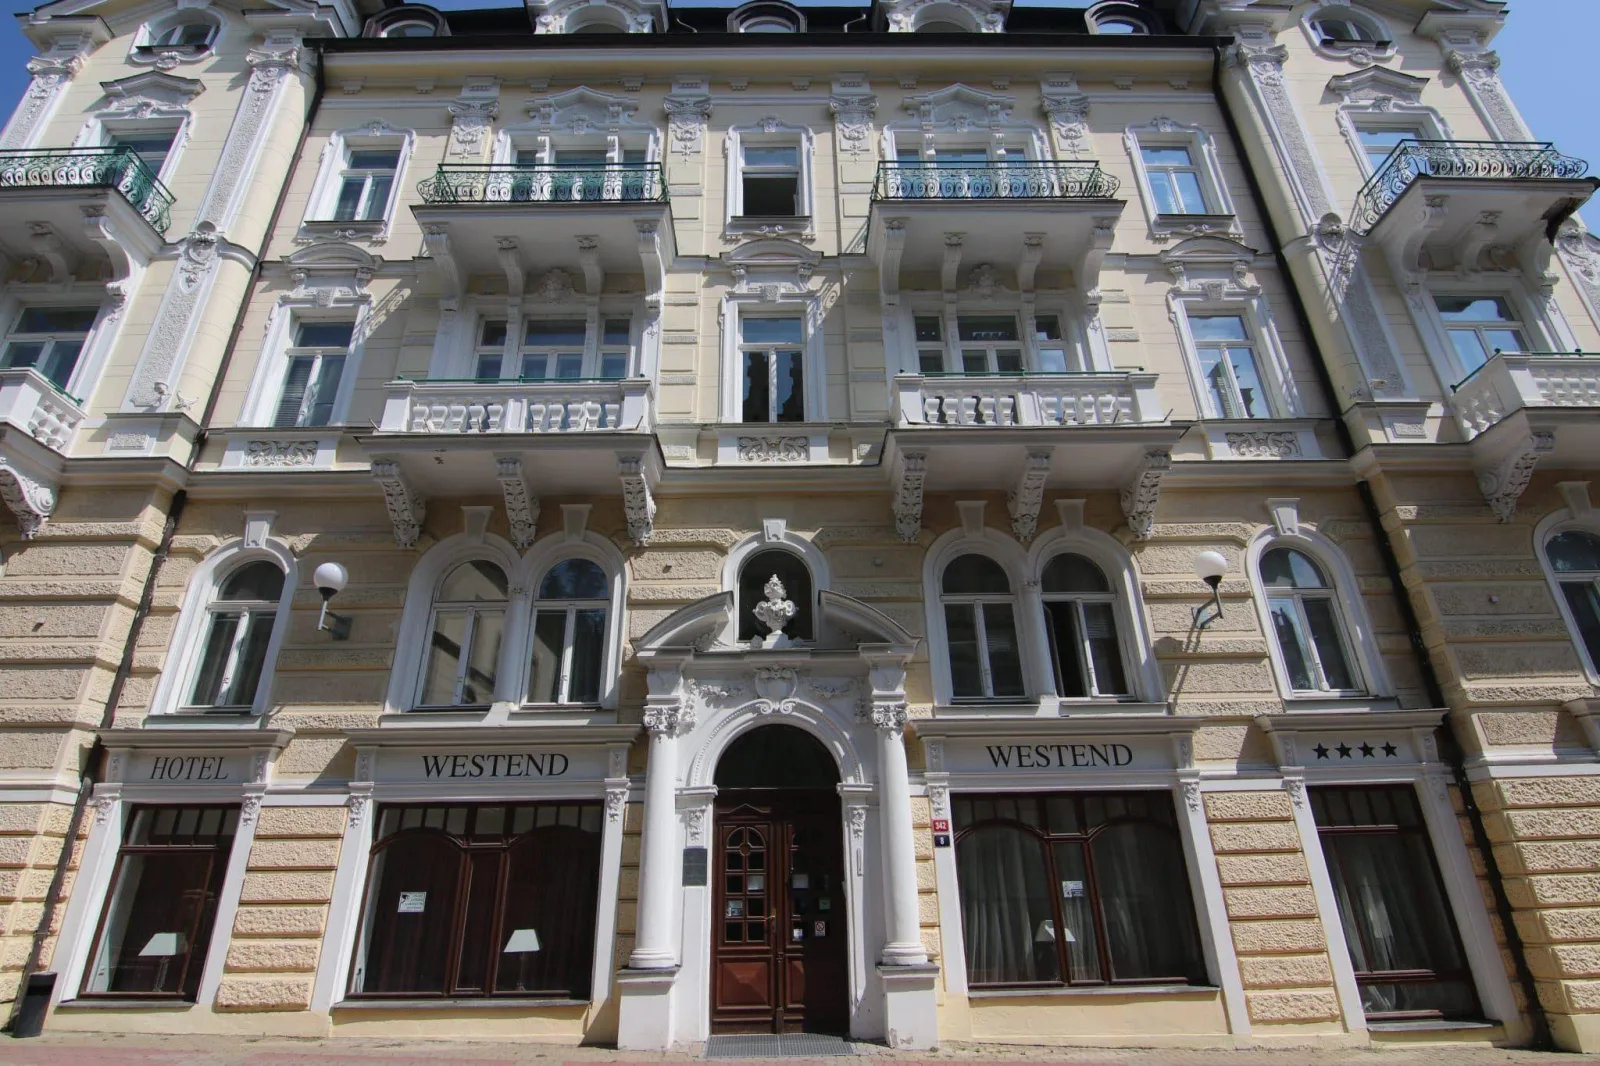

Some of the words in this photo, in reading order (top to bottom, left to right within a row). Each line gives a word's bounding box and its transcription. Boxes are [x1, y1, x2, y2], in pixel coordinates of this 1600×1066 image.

[149, 756, 230, 780] HOTEL
[421, 753, 569, 778] WESTEND
[985, 743, 1133, 768] WESTEND
